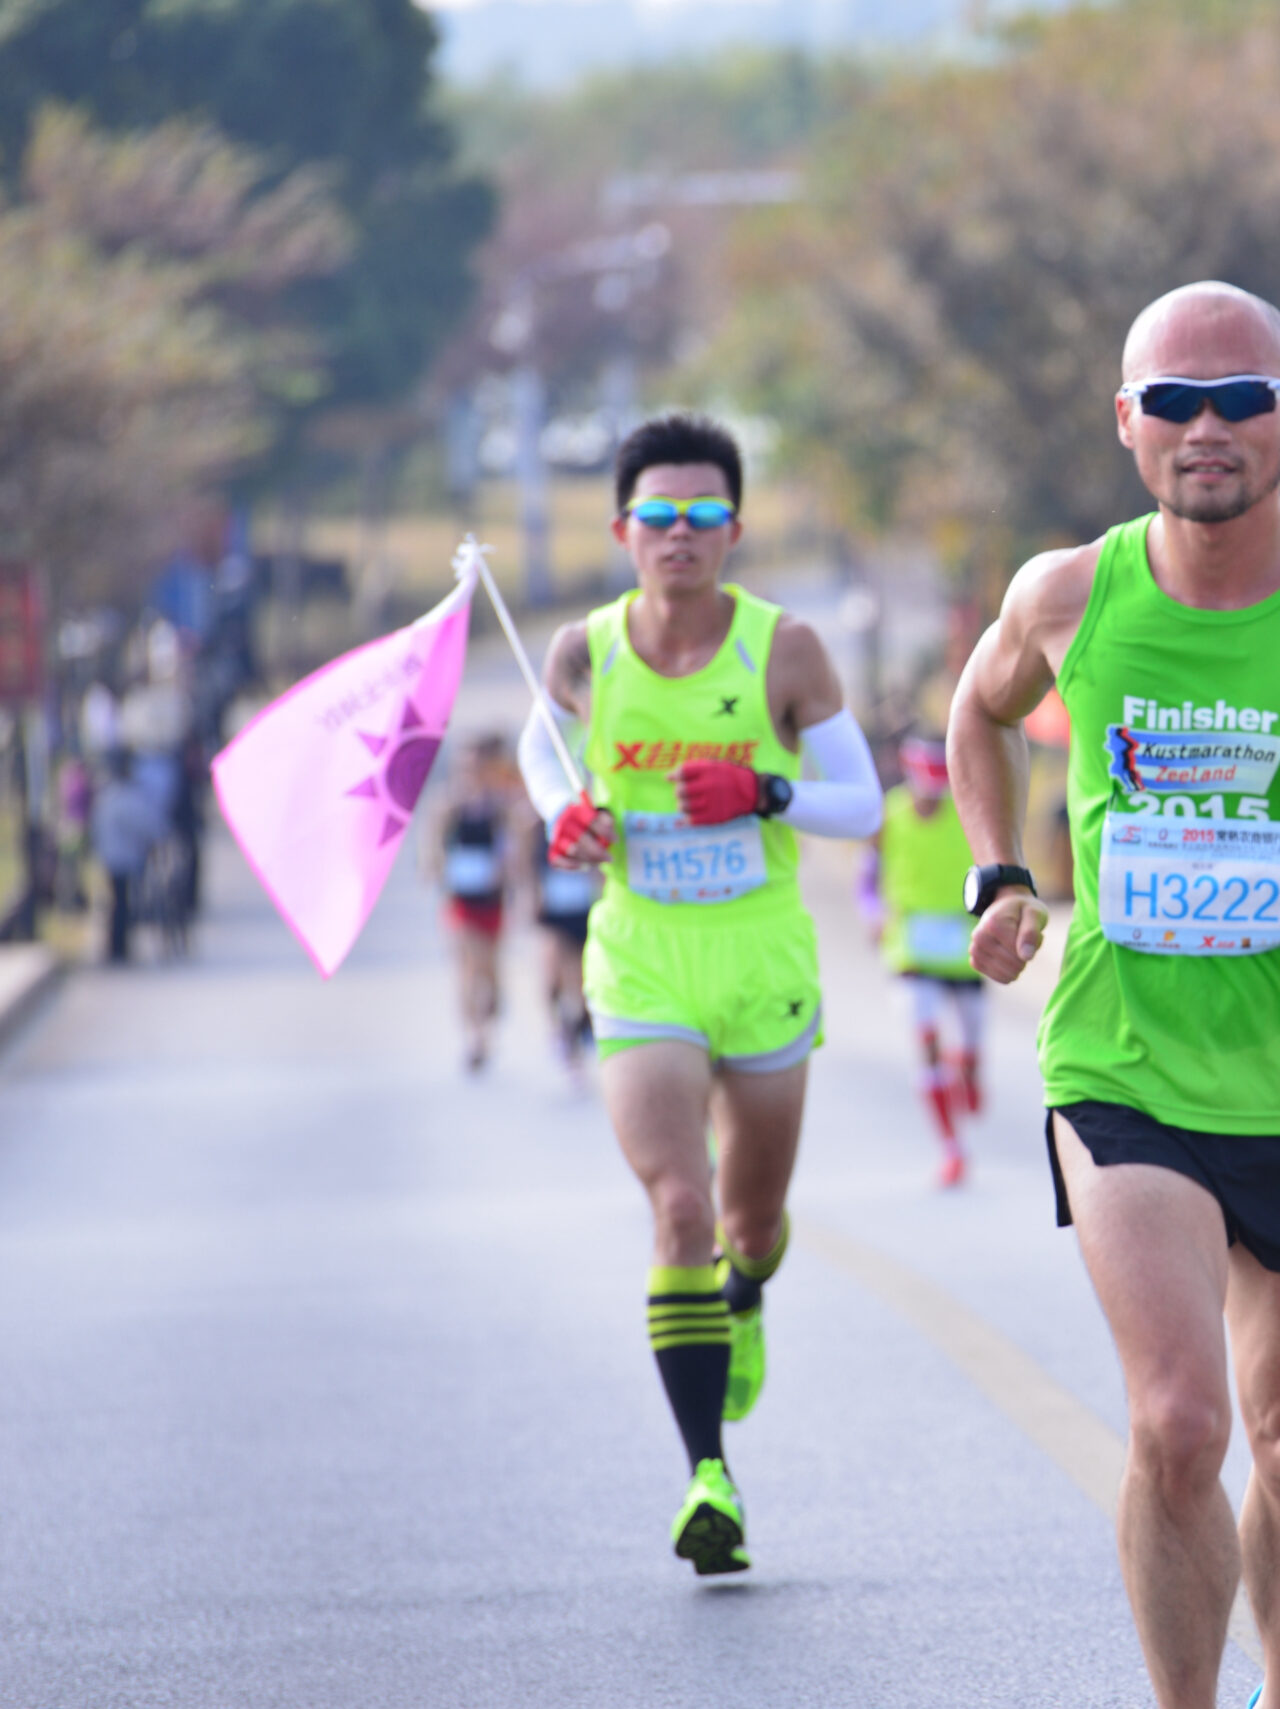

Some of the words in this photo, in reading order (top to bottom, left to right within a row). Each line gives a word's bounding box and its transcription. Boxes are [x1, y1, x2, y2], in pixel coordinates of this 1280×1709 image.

[1123, 695, 1278, 733] Finisher
[1141, 742, 1276, 763] Kustmarathon
[1155, 764, 1237, 784] Zeeland
[1128, 793, 1270, 822] 2015
[1182, 828, 1215, 843] 2015
[643, 840, 747, 881] H1576
[1124, 872, 1280, 922] H3222
